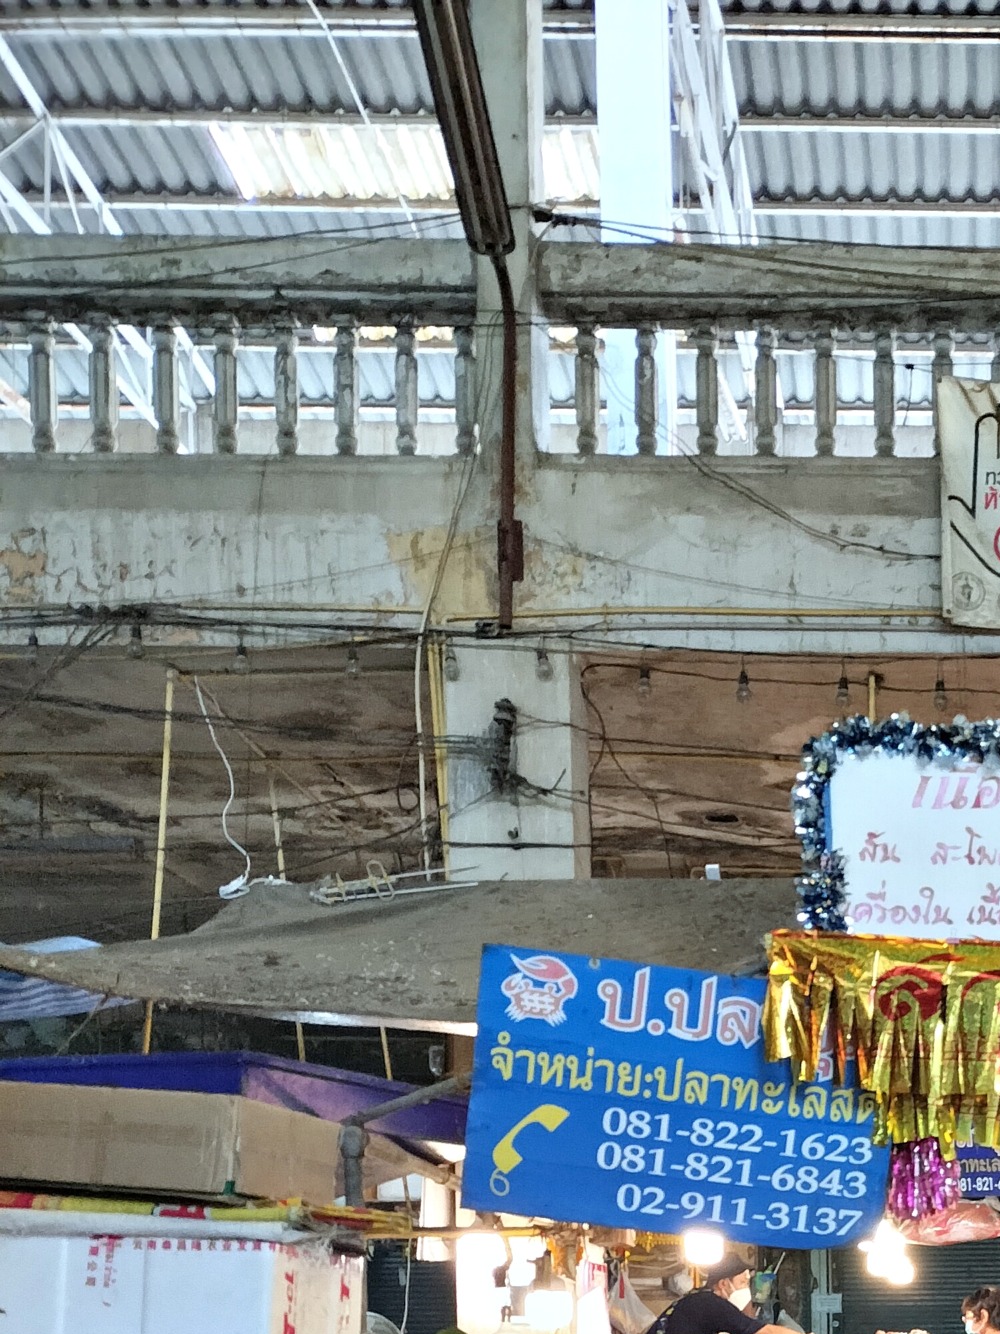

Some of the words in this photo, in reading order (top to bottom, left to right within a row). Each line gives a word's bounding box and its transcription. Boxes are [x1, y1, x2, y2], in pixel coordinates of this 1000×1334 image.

[602, 1106, 873, 1166] 081-822-1623
[596, 1140, 868, 1199] 081-821-6843
[616, 1183, 864, 1237] 02-911-3137
